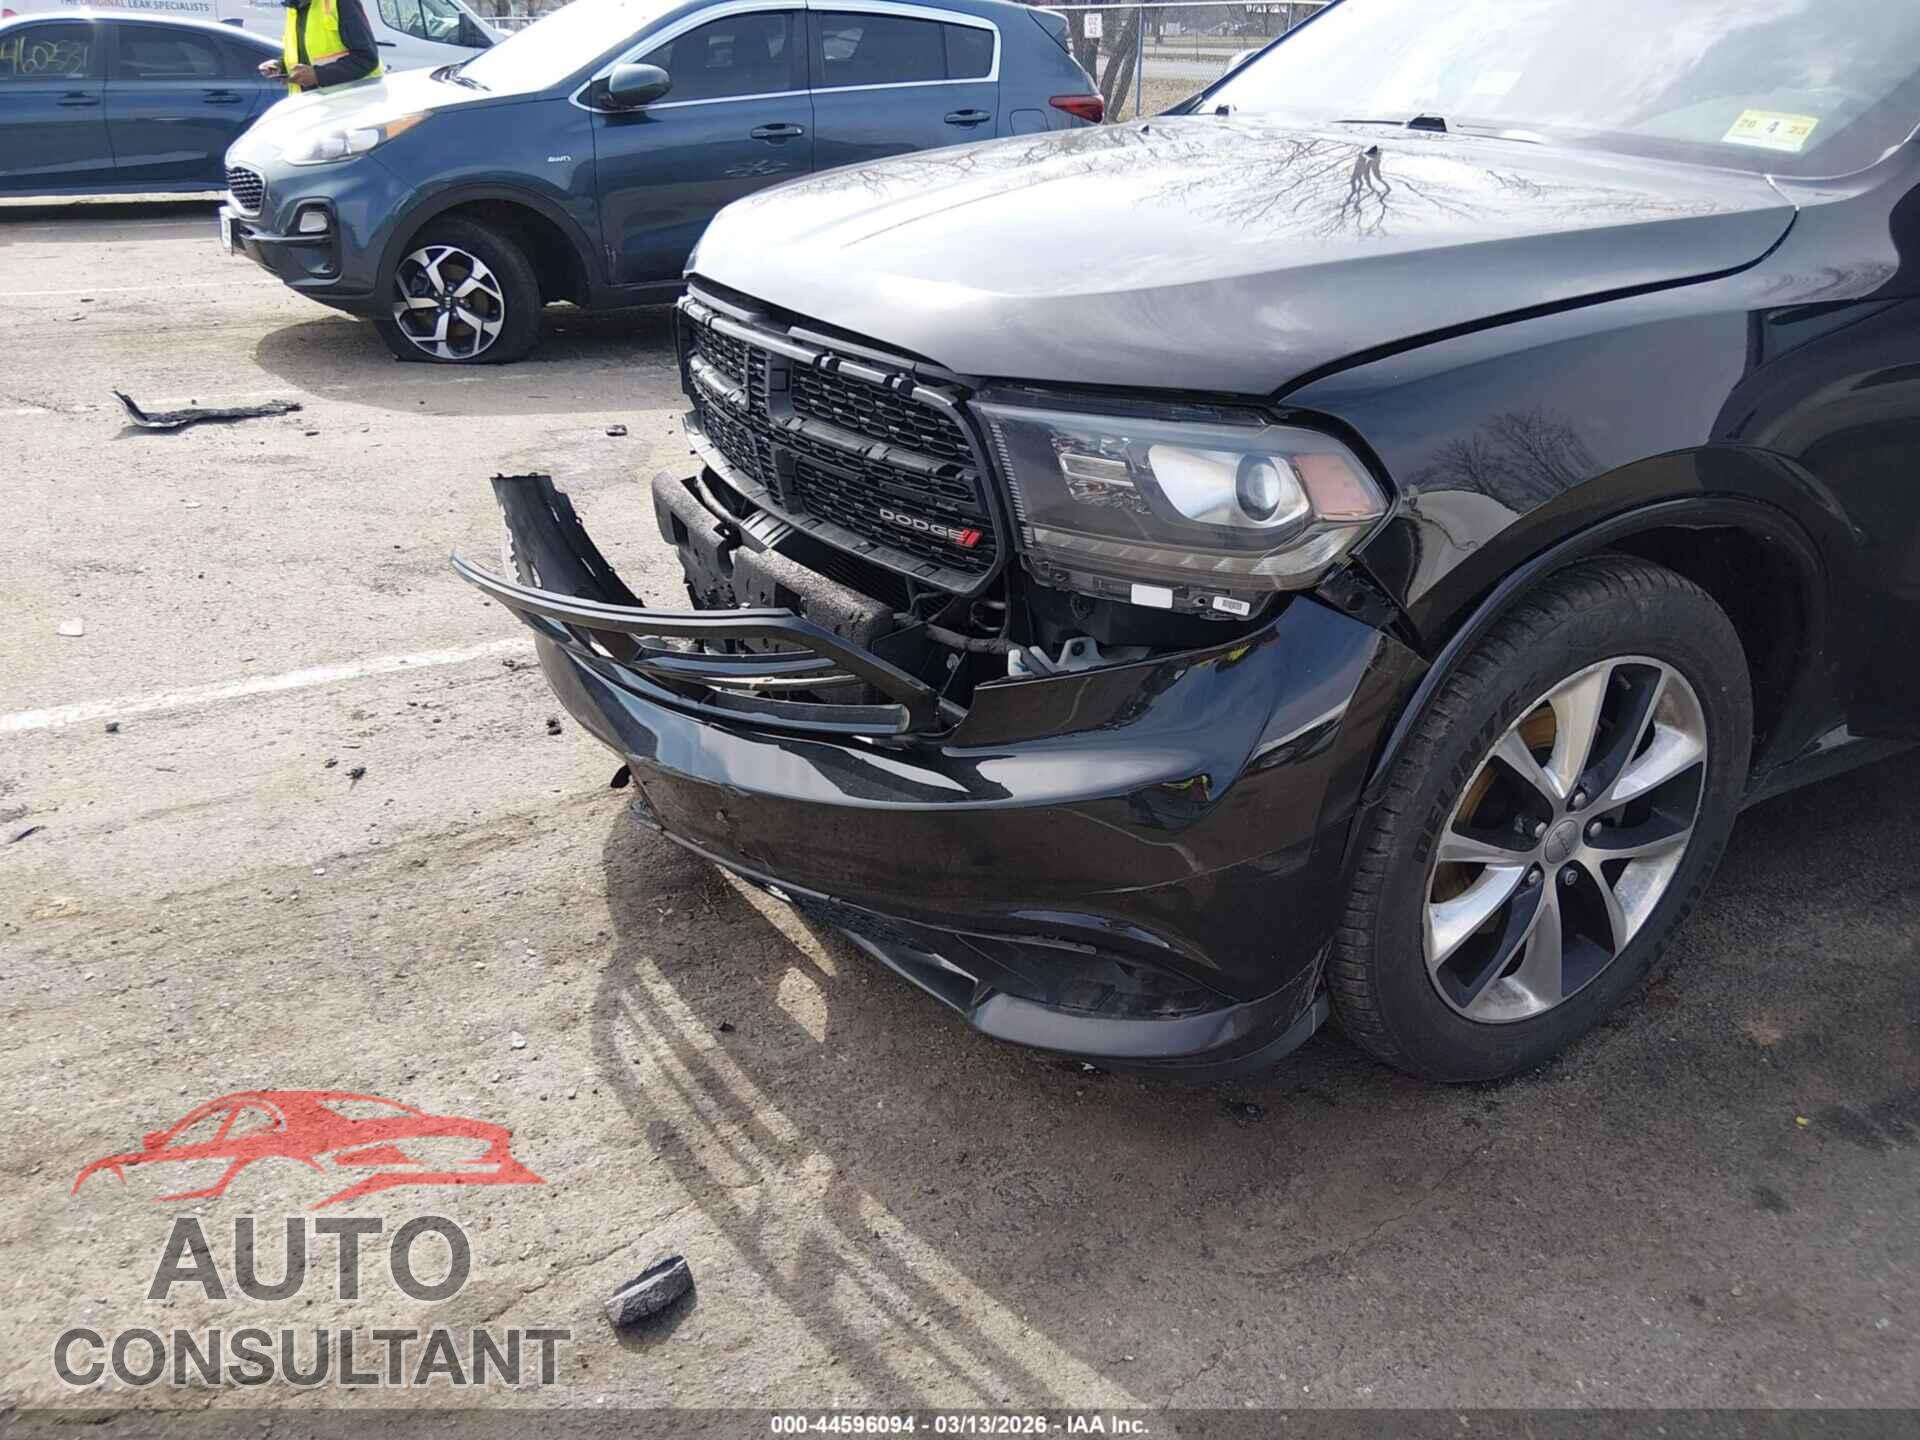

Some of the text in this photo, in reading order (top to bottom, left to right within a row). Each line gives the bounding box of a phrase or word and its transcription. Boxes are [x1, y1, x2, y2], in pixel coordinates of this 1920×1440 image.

[127, 0, 152, 9] LEAK
[152, 1, 210, 12] SPECIALISTS
[879, 508, 966, 543] DODGE
